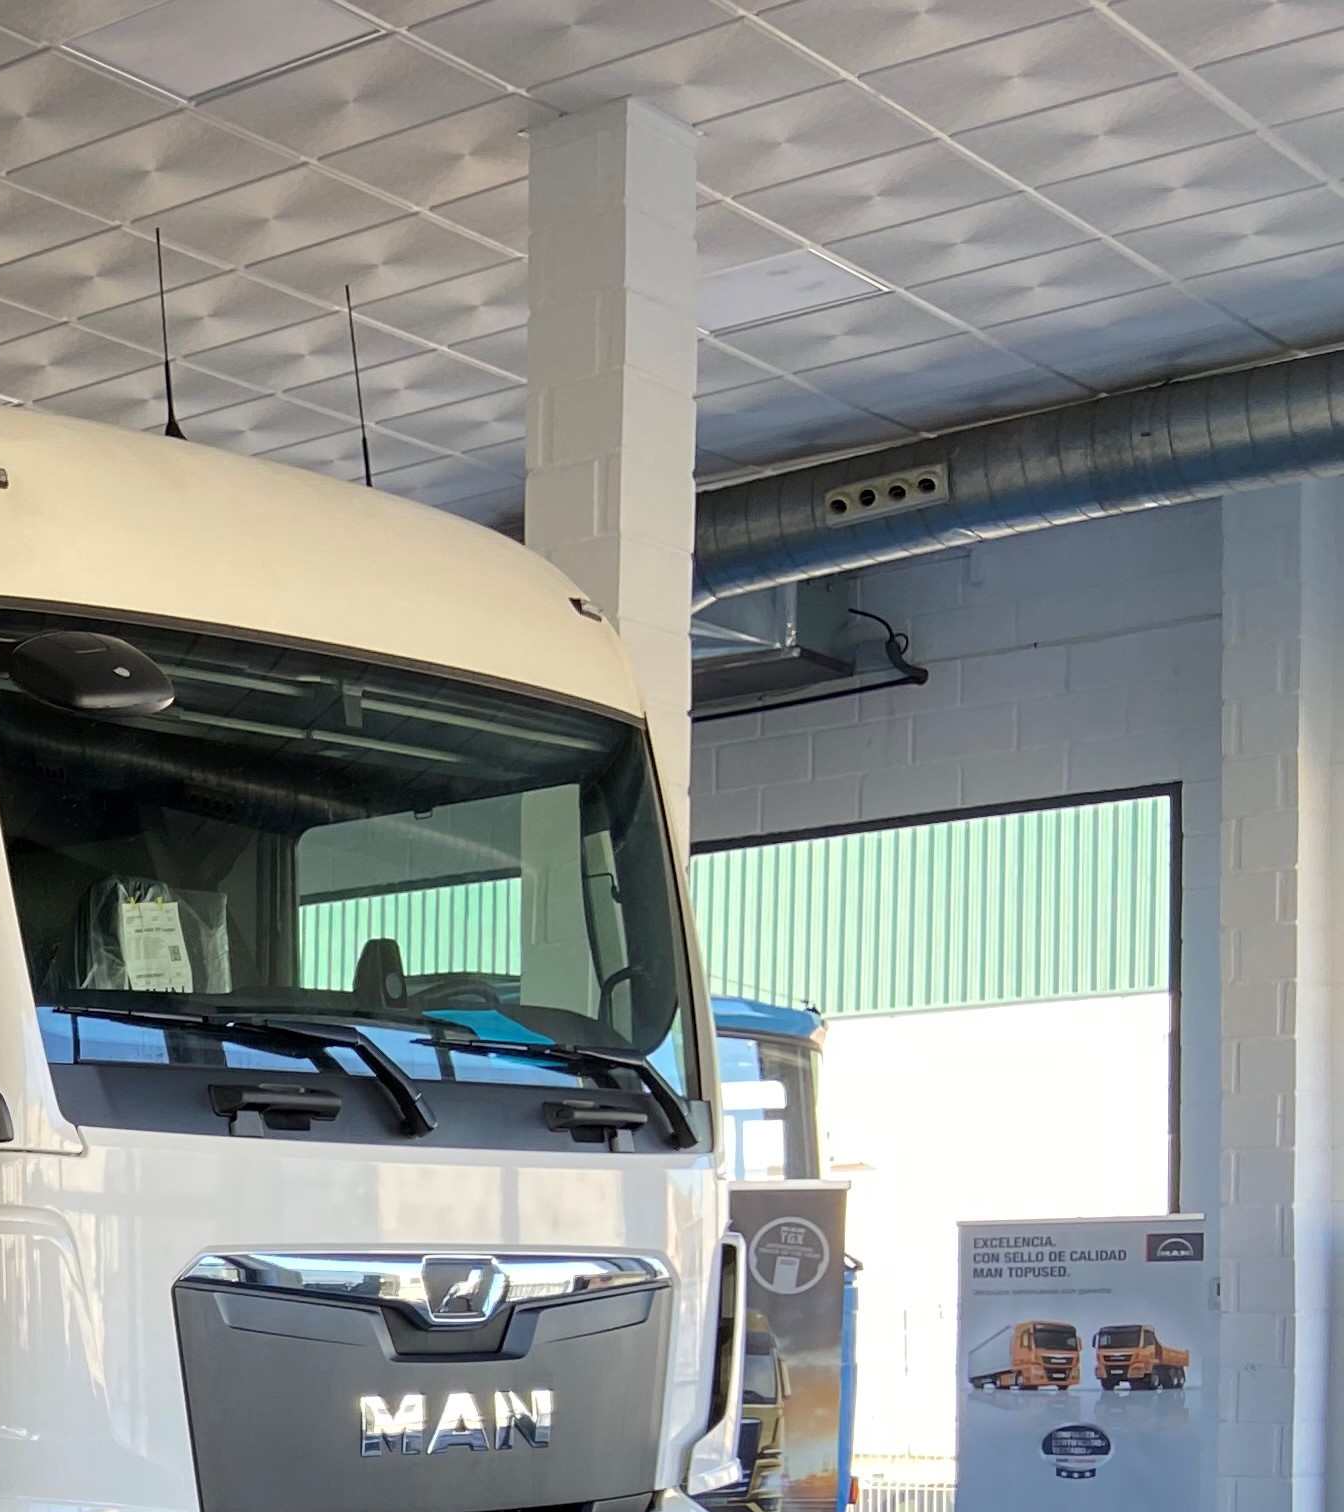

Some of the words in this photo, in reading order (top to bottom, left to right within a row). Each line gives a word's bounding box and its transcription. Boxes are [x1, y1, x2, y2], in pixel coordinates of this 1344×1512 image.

[973, 1236, 1057, 1249] EXCELENCIA.
[973, 1252, 1000, 1264] CON
[1004, 1251, 1044, 1263] SELLO
[1048, 1250, 1066, 1262] DE
[1069, 1249, 1127, 1262] CALIDAD
[973, 1267, 1003, 1278] MAN
[359, 1389, 553, 1457] MAN
